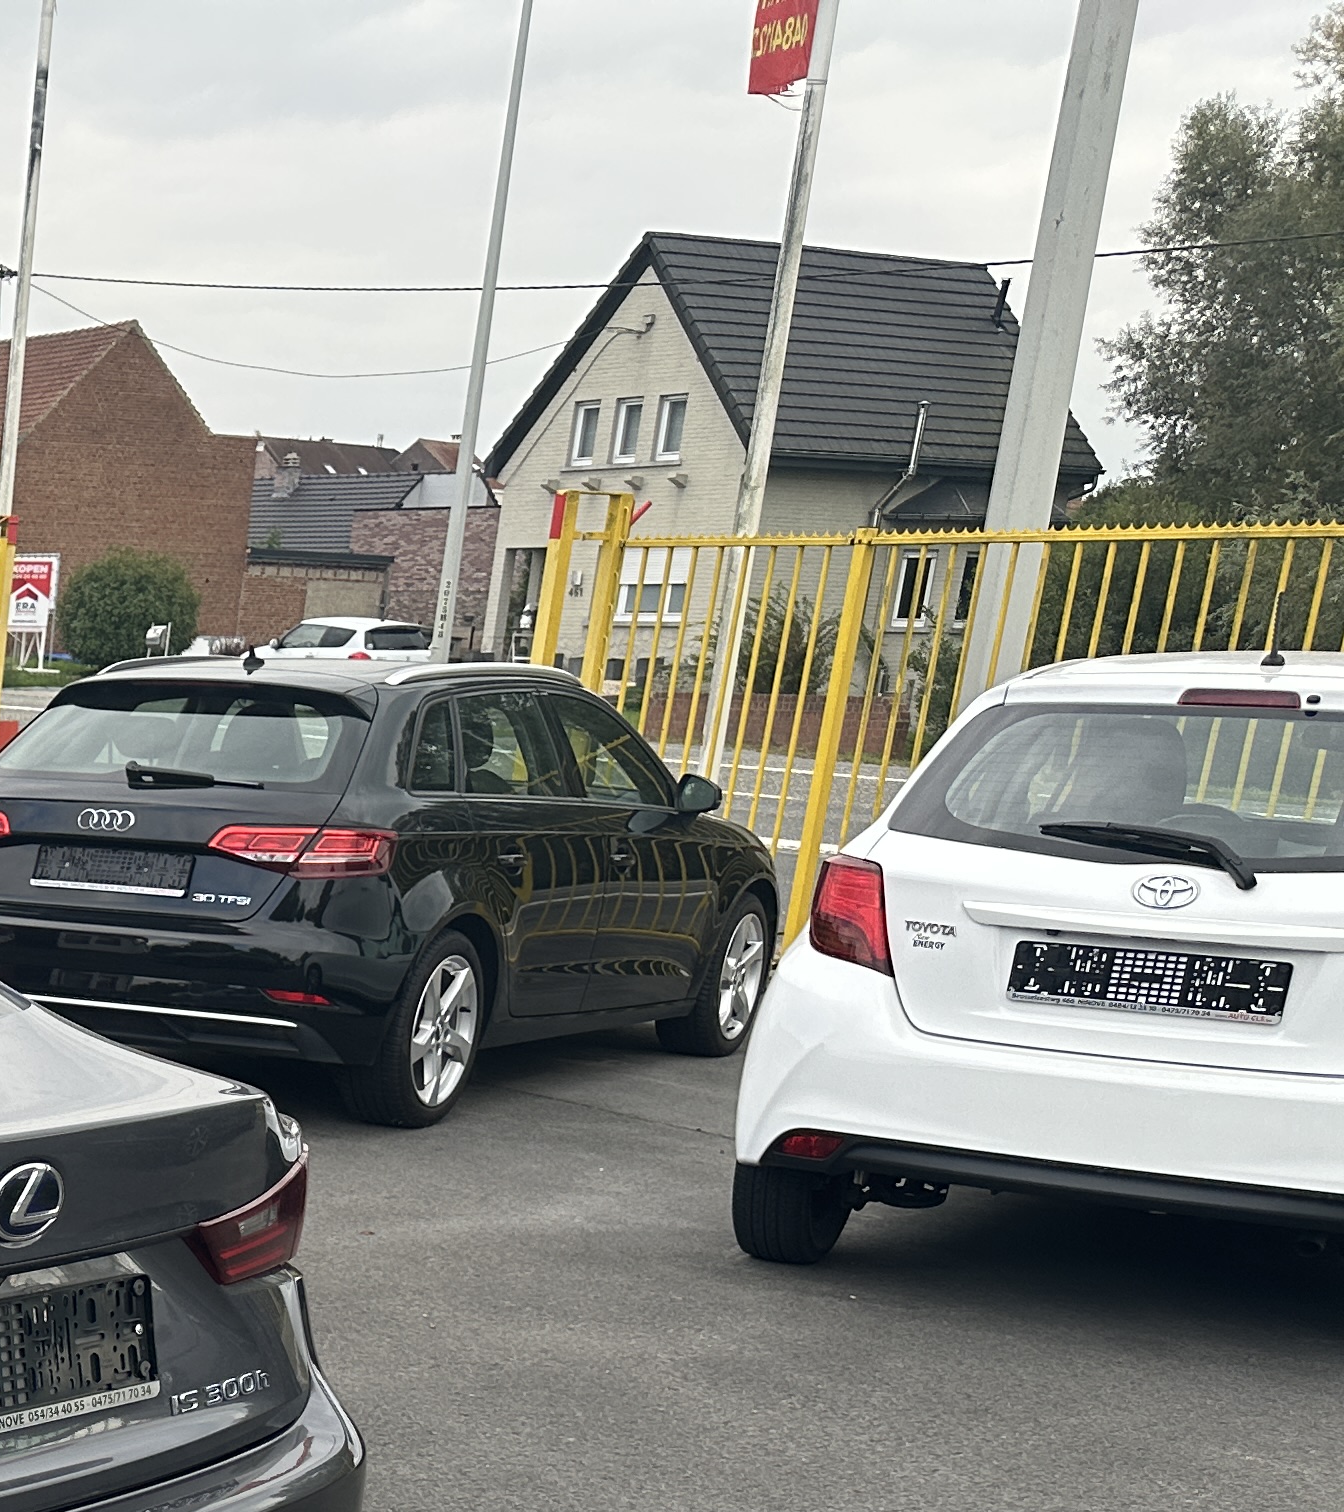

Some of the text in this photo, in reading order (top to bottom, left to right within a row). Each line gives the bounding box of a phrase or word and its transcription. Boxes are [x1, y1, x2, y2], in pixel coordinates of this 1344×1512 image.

[15, 602, 37, 610] ERA
[192, 892, 252, 906] 30 TFSI
[904, 920, 957, 937] TOYOTA
[912, 940, 946, 950] ENERGY
[170, 1369, 271, 1416] IS 300h
[28, 1406, 60, 1423] 054/34
[61, 1402, 73, 1416] 40
[74, 1399, 85, 1413] 55
[91, 1390, 126, 1408] 0475/71
[128, 1387, 140, 1400] 70
[140, 1384, 152, 1397] 34
